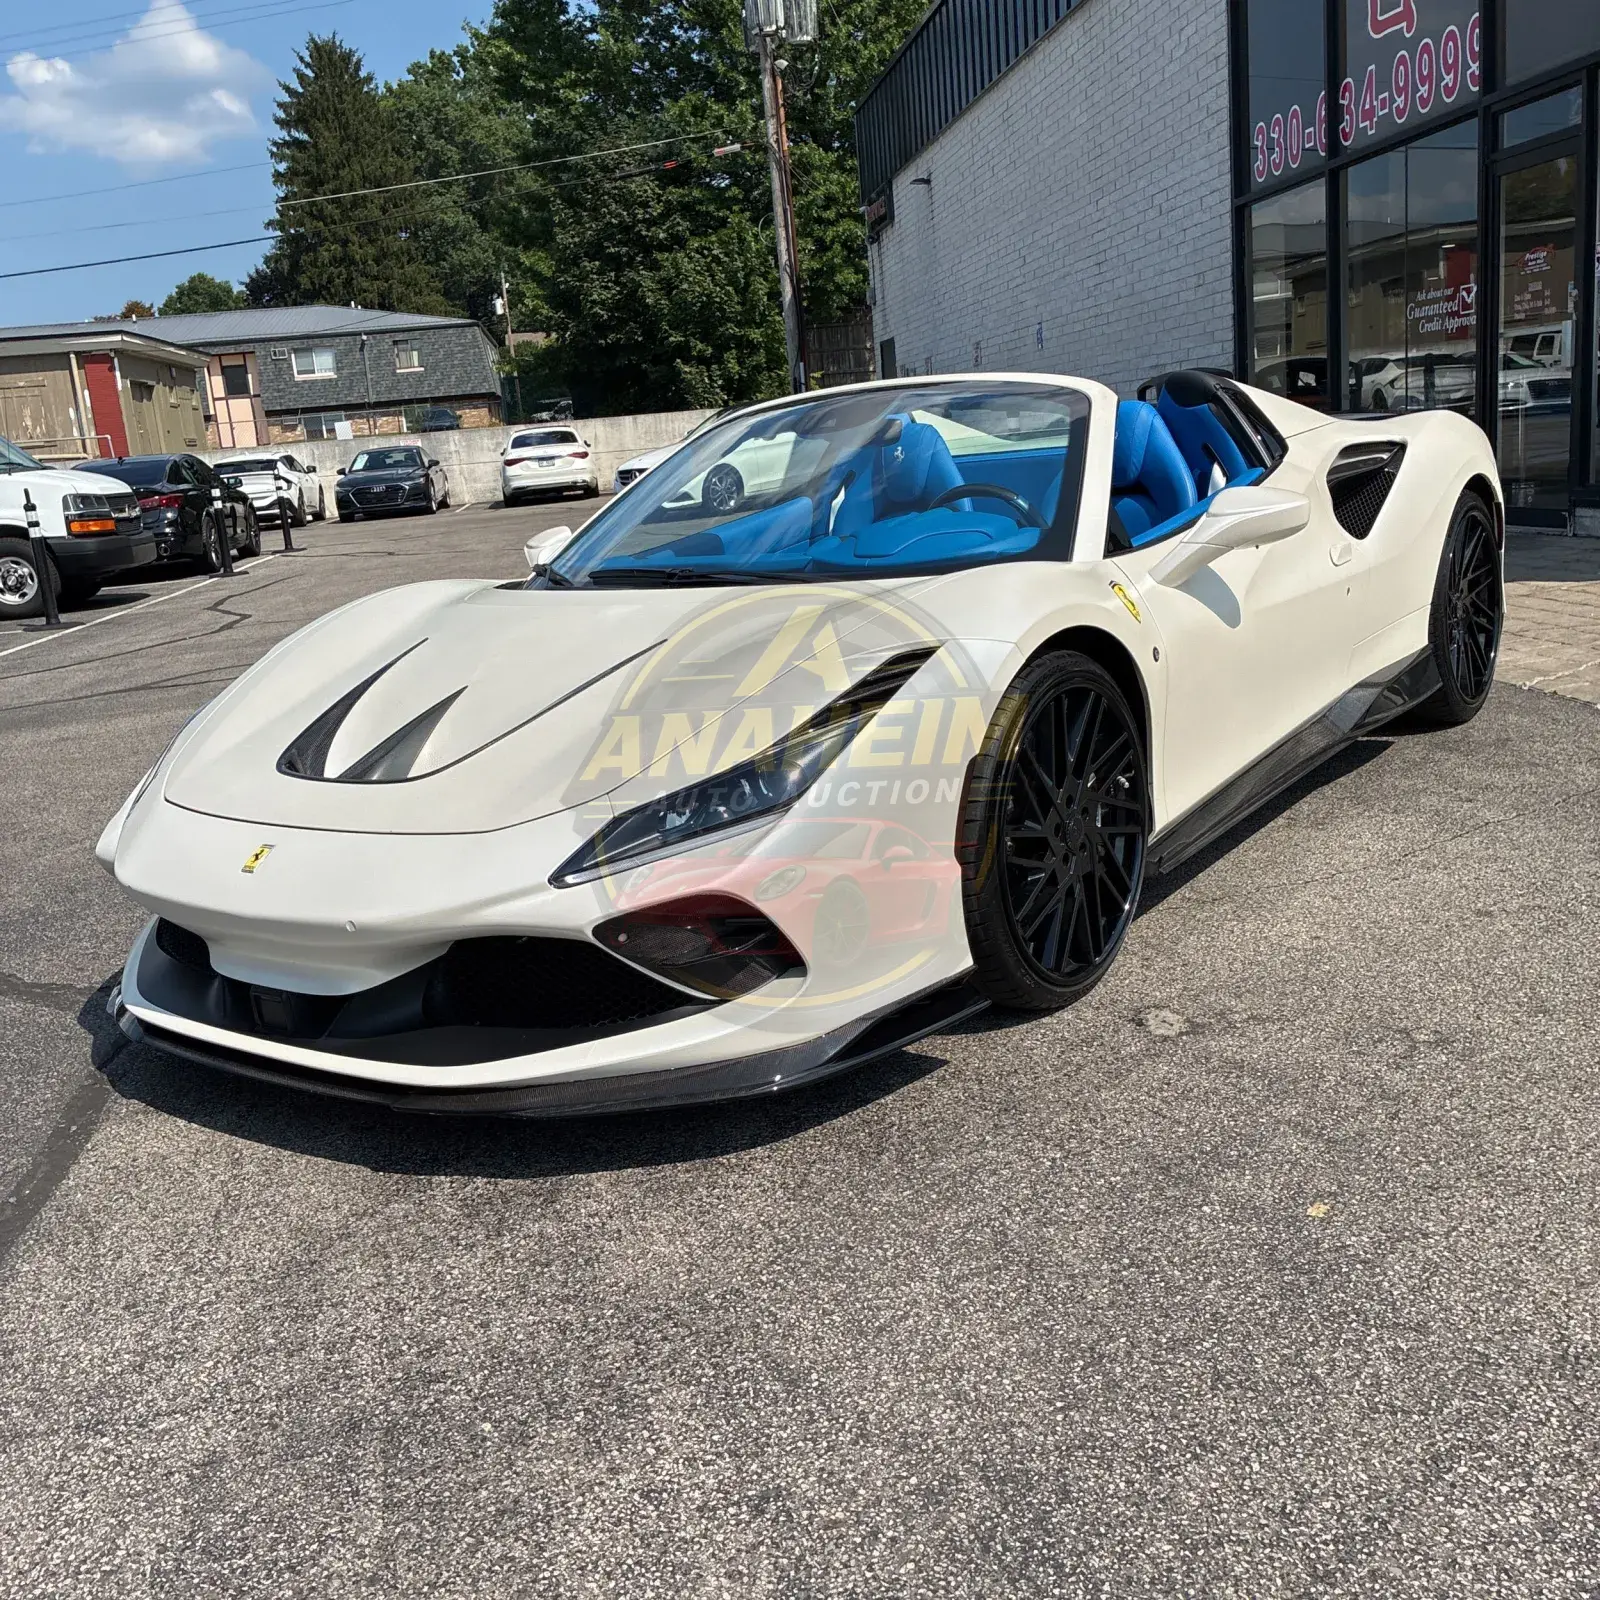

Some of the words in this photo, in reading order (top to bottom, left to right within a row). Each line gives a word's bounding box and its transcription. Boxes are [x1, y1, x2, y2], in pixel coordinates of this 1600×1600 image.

[1416, 290, 1426, 301] Ask
[1427, 288, 1443, 299] about
[1444, 287, 1454, 296] our
[1407, 293, 1460, 319] Guaranteed
[1419, 317, 1442, 333] Credit
[1442, 315, 1477, 334] Approva
